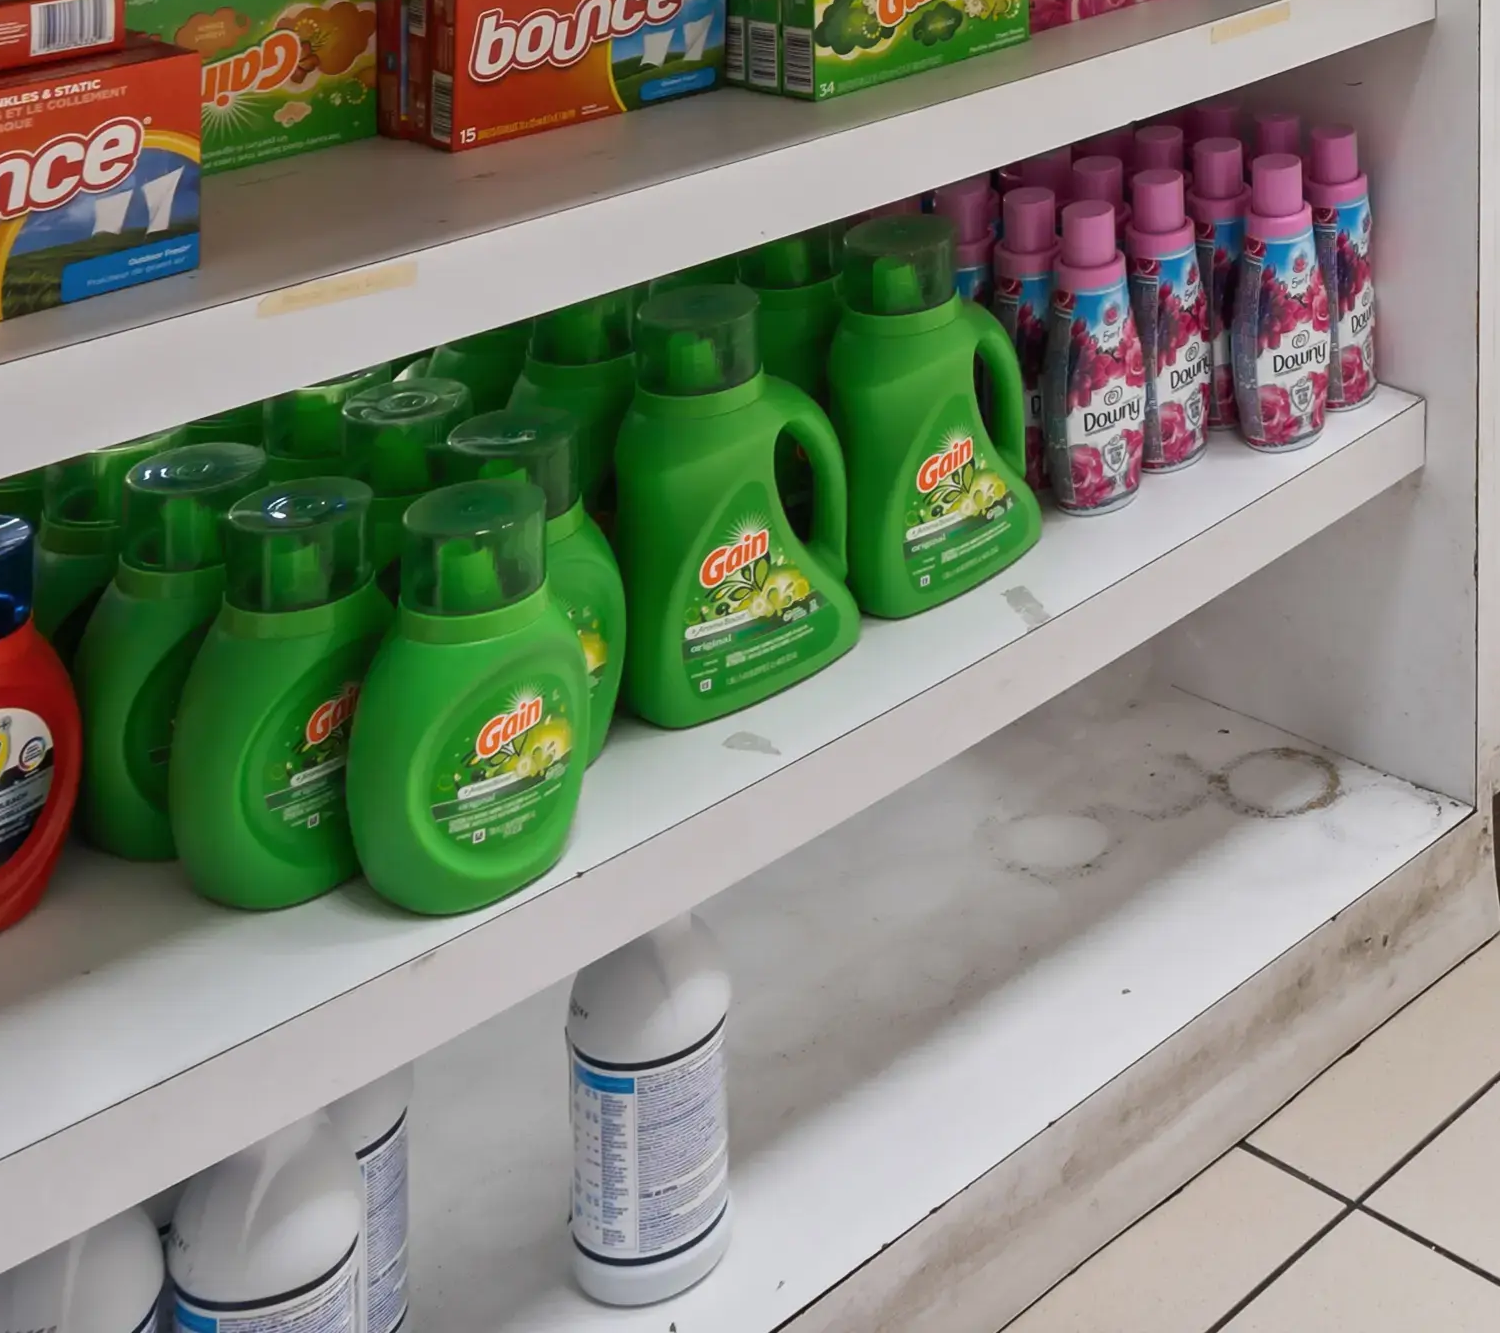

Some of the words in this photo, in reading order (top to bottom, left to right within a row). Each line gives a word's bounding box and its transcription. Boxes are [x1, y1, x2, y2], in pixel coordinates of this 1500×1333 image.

[41, 89, 53, 102] &
[54, 78, 102, 100] STATIC
[46, 85, 129, 112] COLLEMENT
[820, 81, 835, 97] 34
[459, 127, 477, 144] 15
[1273, 341, 1328, 374] Downy
[1083, 398, 1141, 433] Downy
[916, 437, 973, 493] Gain
[700, 529, 769, 588] Gain
[689, 634, 732, 654] original
[477, 696, 543, 758] Gain
